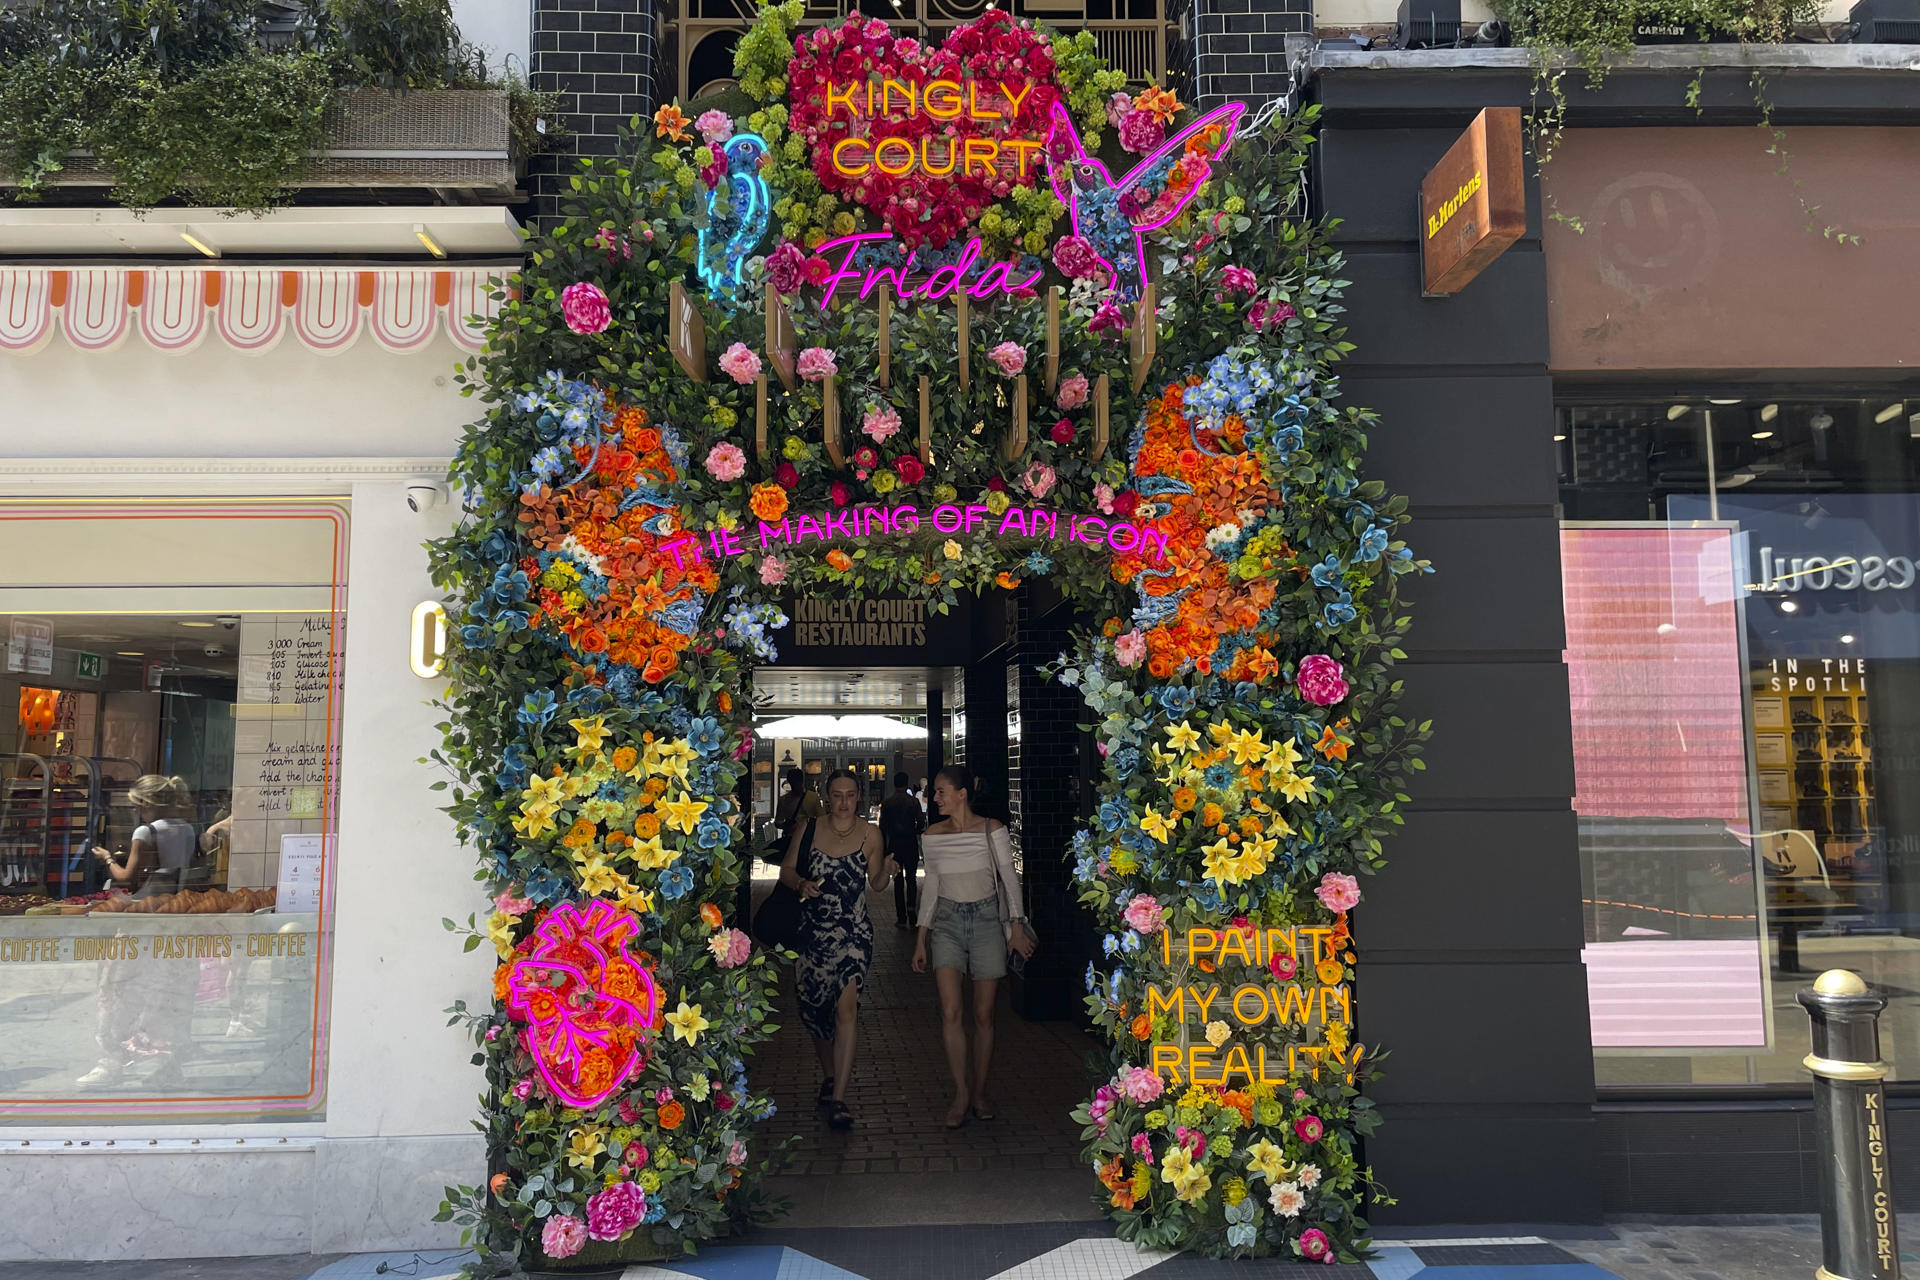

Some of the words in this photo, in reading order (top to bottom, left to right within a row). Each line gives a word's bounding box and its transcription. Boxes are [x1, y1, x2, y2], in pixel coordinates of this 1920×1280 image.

[827, 79, 1032, 119] KINGLY
[832, 137, 1043, 177] COURT
[815, 232, 1042, 310] Frida
[759, 504, 919, 548] MAKING
[932, 505, 990, 533] OF
[998, 507, 1057, 539] AN
[1069, 514, 1169, 561] ICON
[865, 599, 927, 622] COURT
[297, 638, 322, 648] Cream
[795, 623, 926, 646] RESTAURANTS
[1771, 676, 1866, 692] SPOTLI
[1772, 658, 1798, 674] IN
[1821, 658, 1865, 674] THE
[1, 936, 60, 962] COFFEE
[73, 936, 139, 961] DONUTS
[153, 934, 232, 959] PASTRIES
[247, 932, 306, 957] COFFEE
[1163, 928, 1171, 965] I
[1188, 928, 1333, 967] PAINT
[1149, 985, 1219, 1024] MY
[1233, 986, 1351, 1025] OWN
[1152, 1045, 1364, 1086] REALITY
[1865, 1093, 1884, 1189] KINGLY
[1873, 1191, 1891, 1271] COURT
